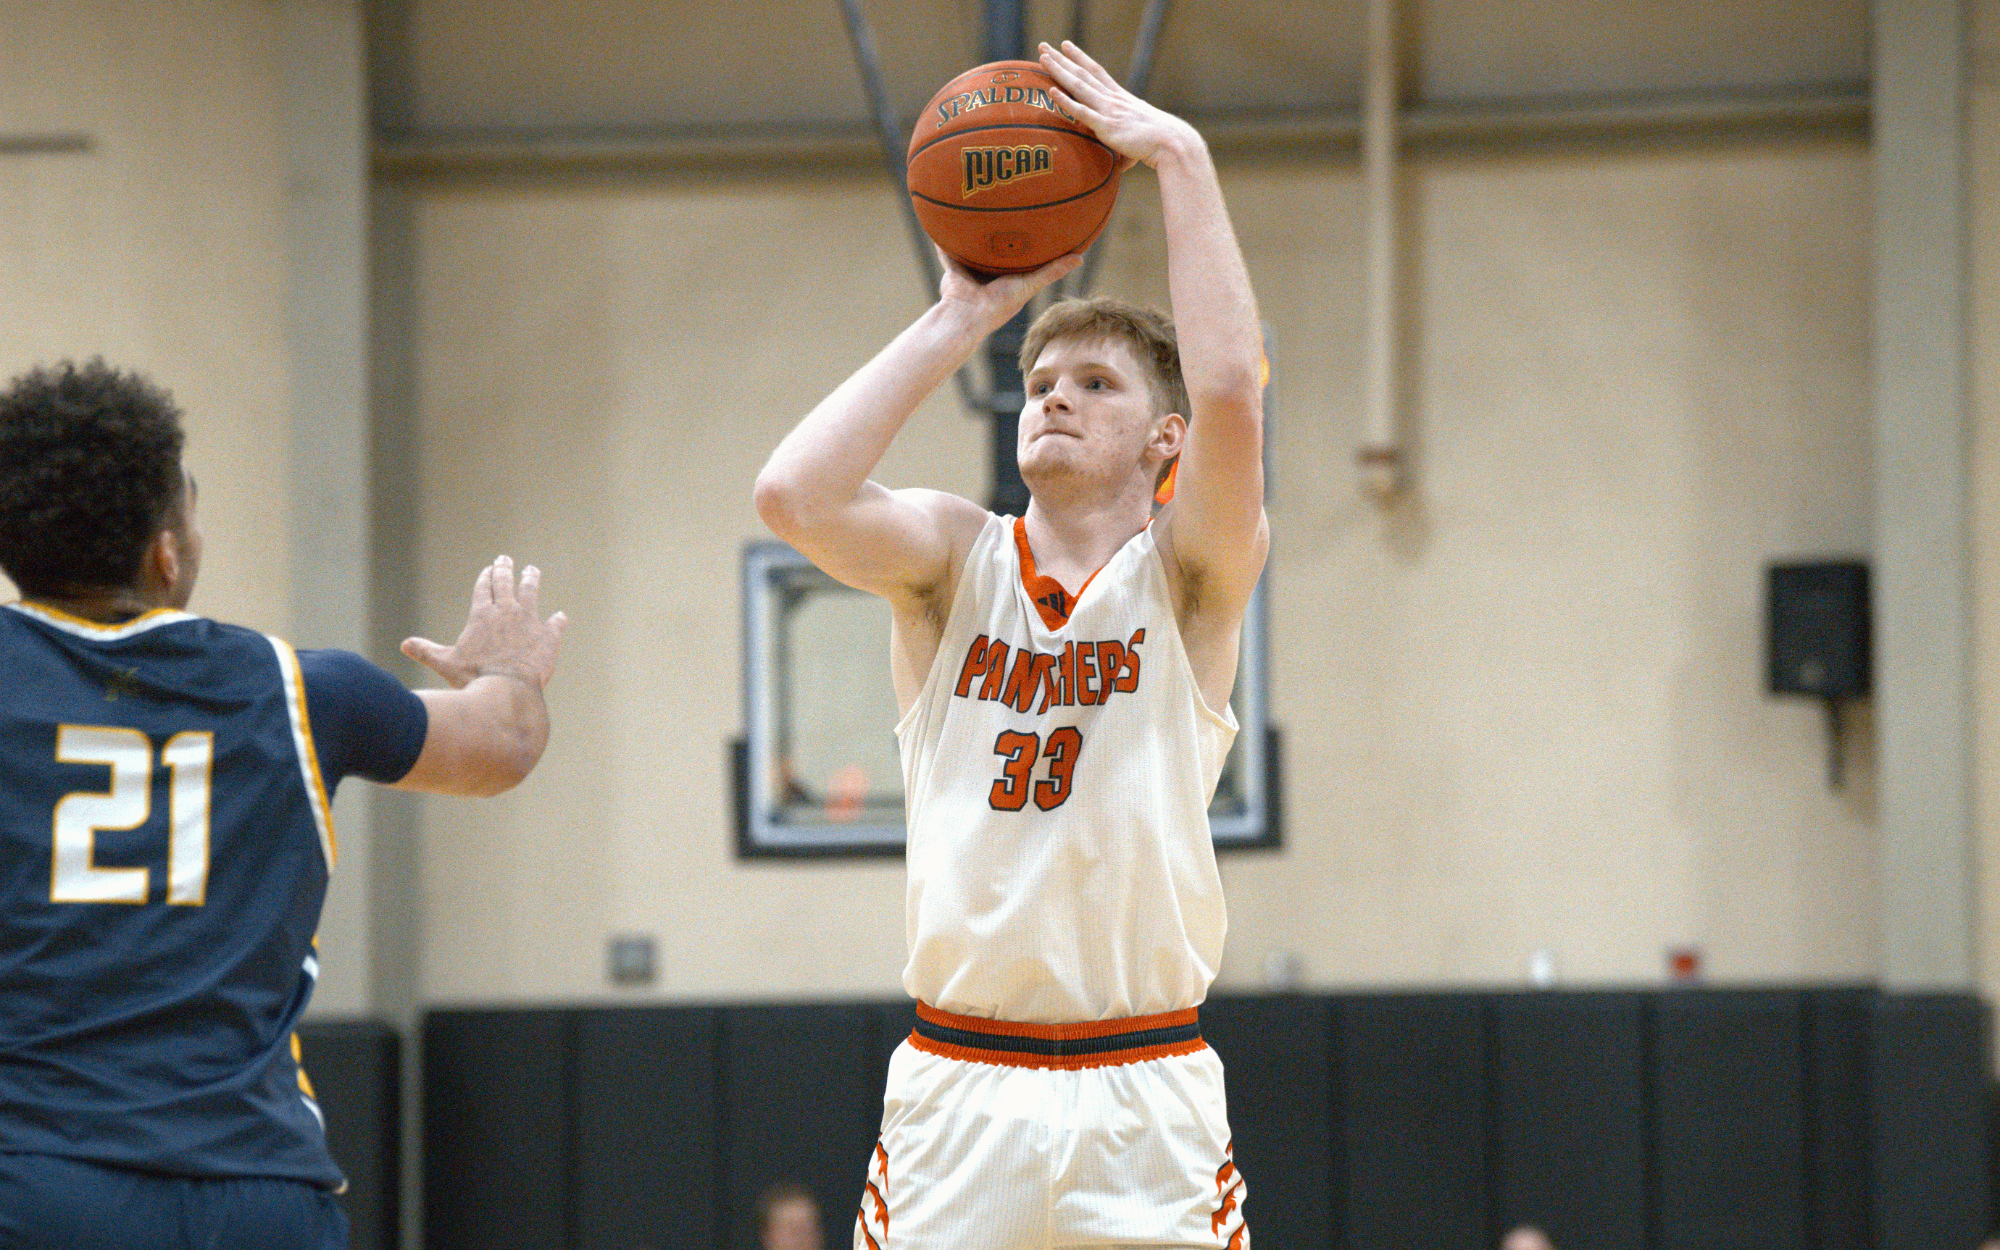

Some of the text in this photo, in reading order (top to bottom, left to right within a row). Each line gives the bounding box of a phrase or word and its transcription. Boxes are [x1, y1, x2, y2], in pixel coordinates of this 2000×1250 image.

[962, 145, 1053, 198] NJCAA
[954, 628, 1146, 715] PANTHERS
[988, 725, 1083, 812] 33
[50, 723, 213, 905] 21
